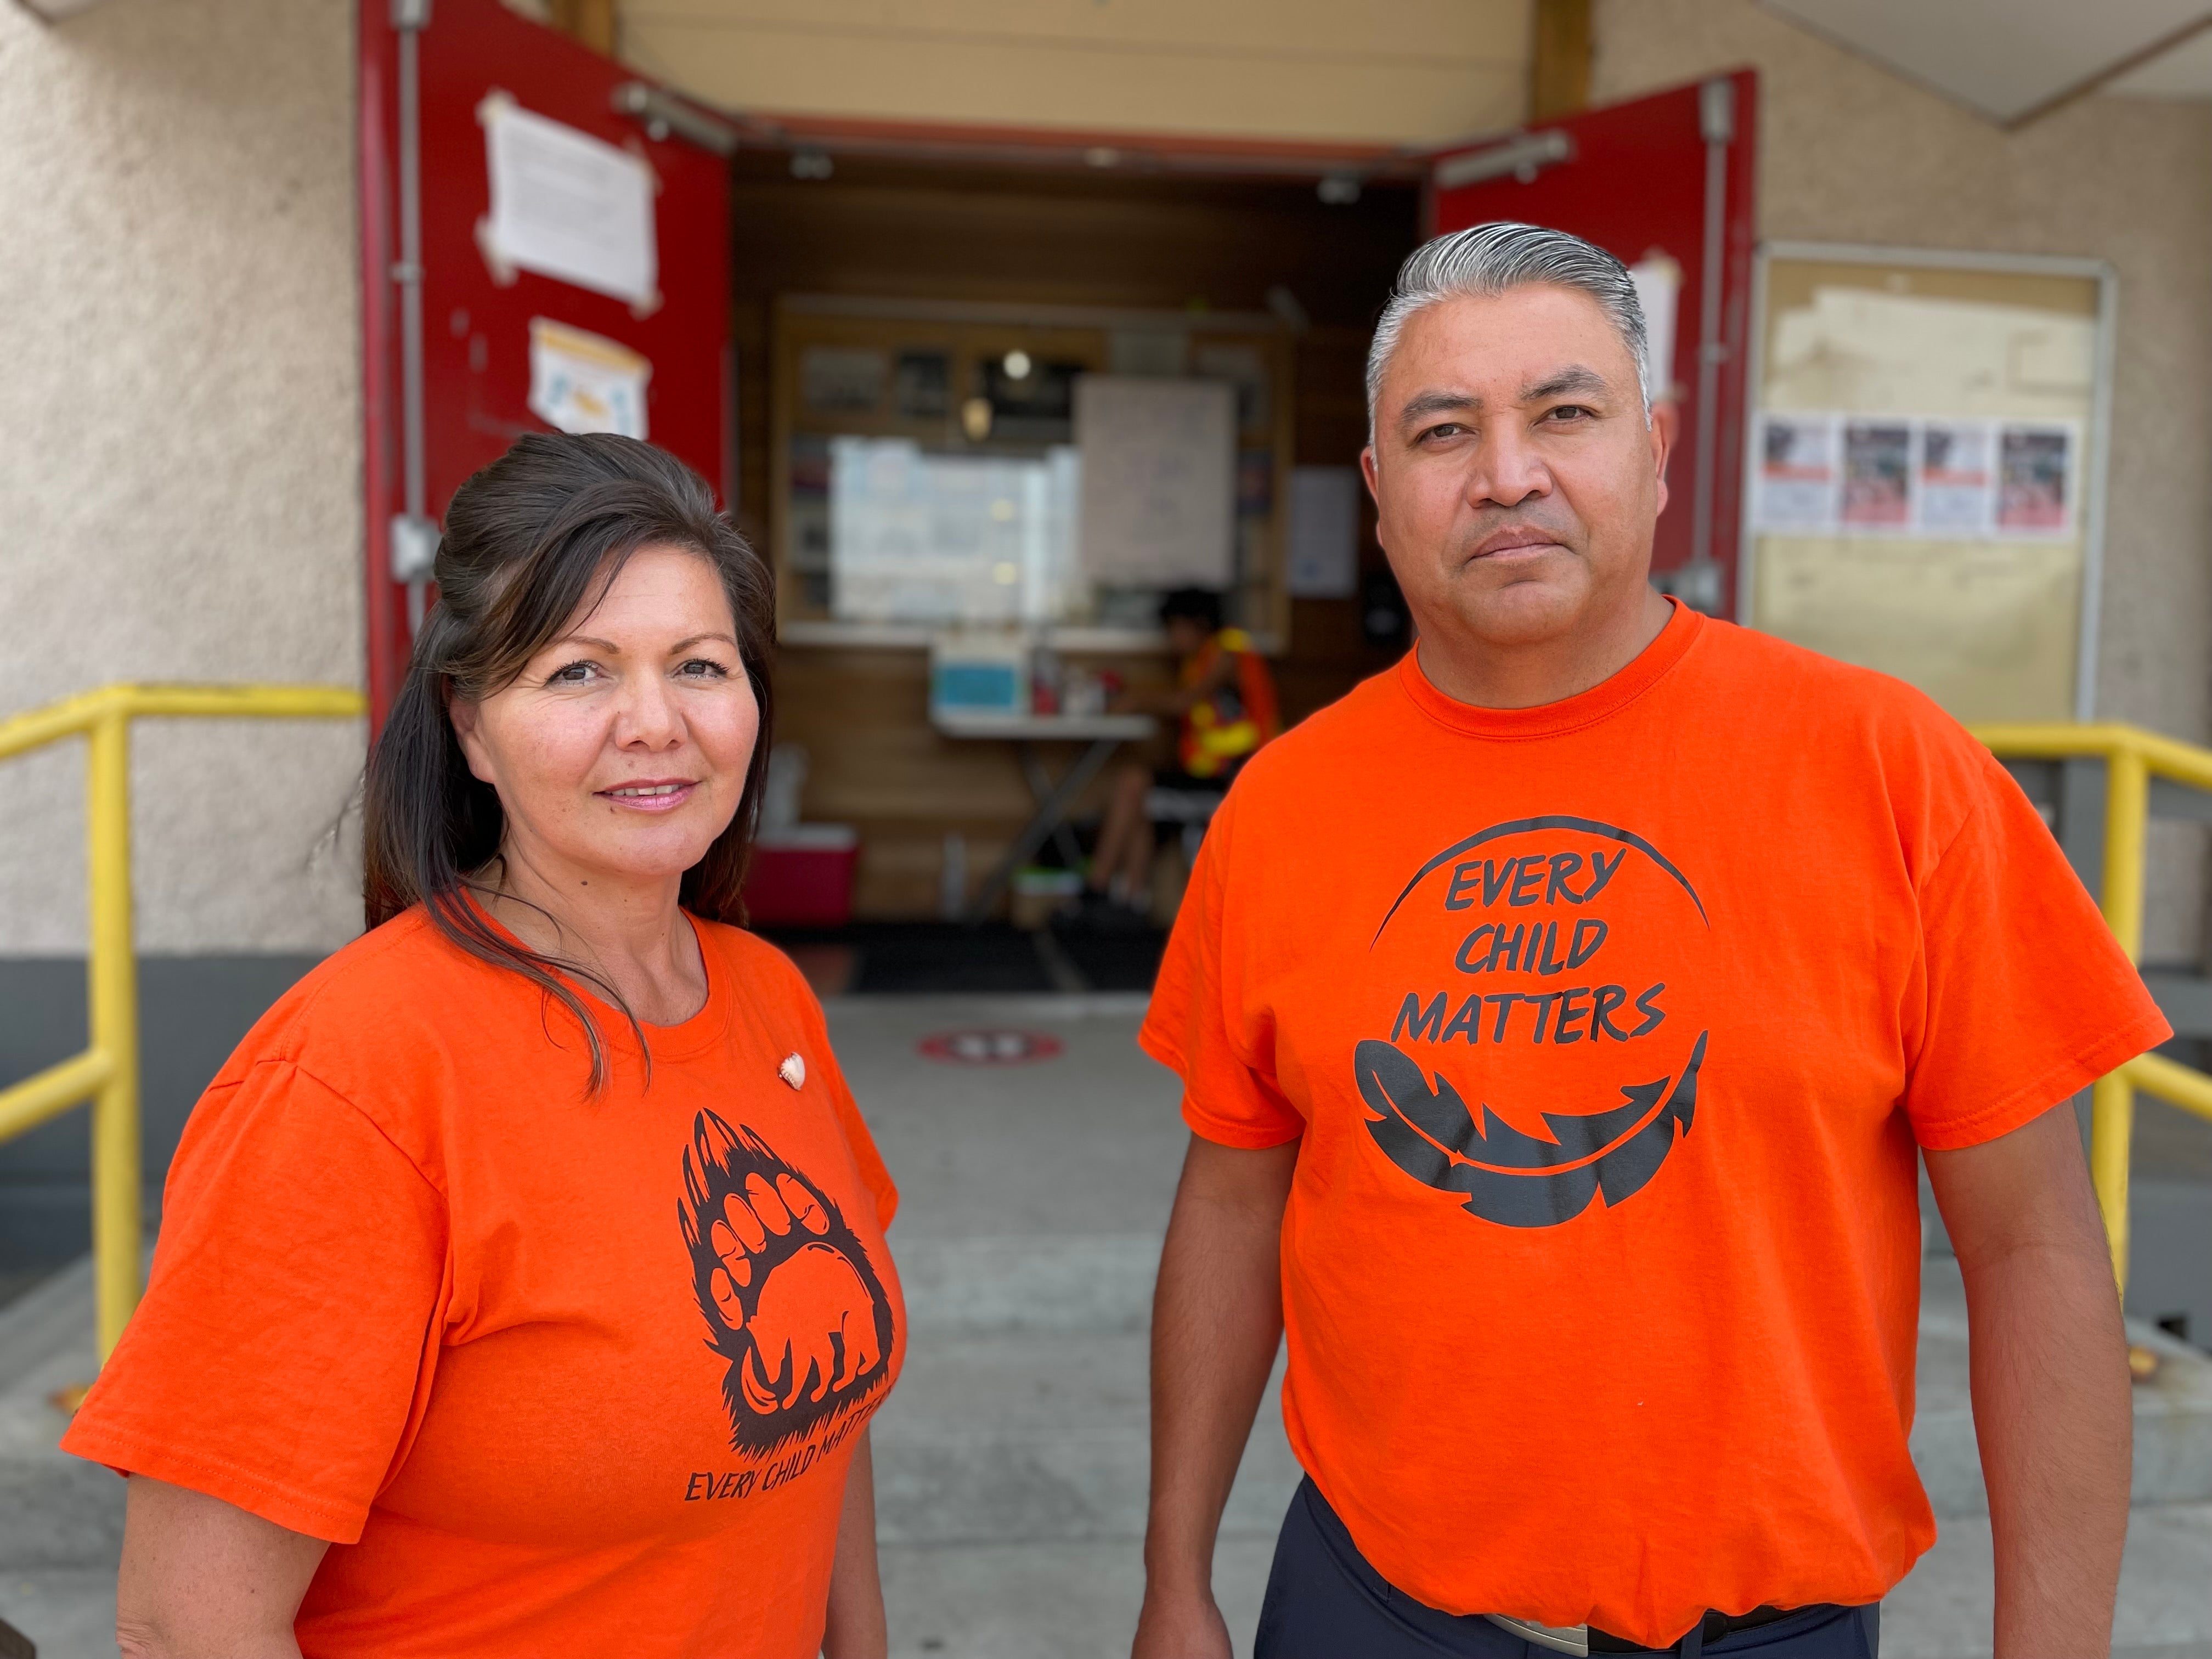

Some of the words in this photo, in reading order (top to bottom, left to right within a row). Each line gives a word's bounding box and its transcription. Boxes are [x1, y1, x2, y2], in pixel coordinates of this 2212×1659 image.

[1444, 848, 1627, 911] EVERY
[1455, 919, 1609, 976] CHILD
[1391, 983, 1666, 1046] MATTERS
[685, 1468, 763, 1501] EVERY
[762, 1444, 816, 1491] CHILD
